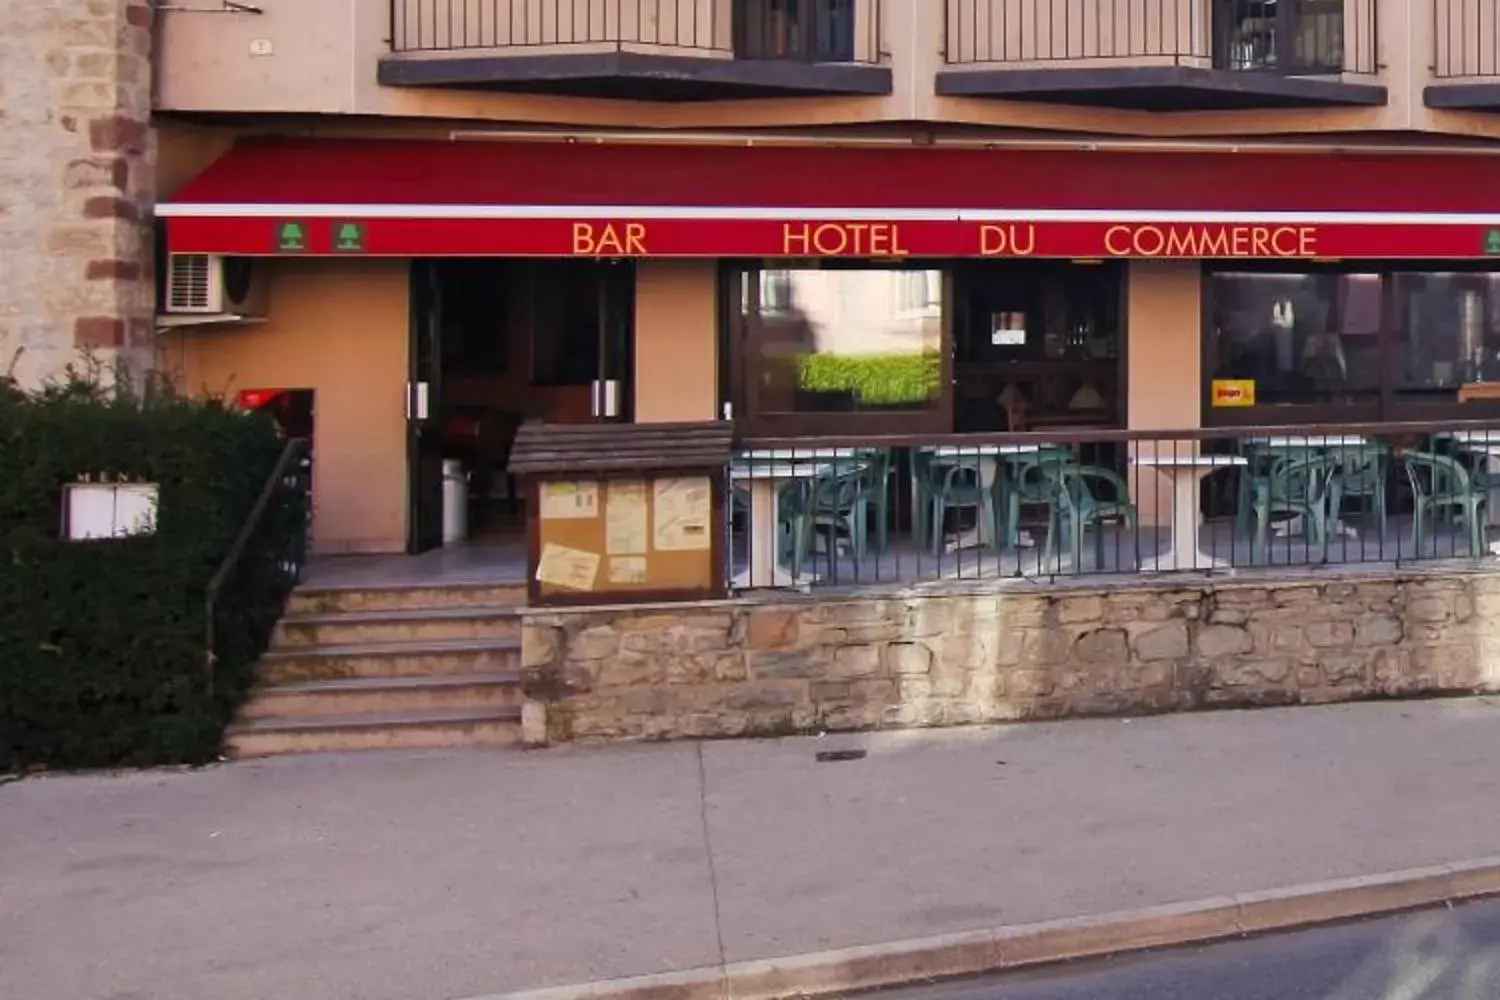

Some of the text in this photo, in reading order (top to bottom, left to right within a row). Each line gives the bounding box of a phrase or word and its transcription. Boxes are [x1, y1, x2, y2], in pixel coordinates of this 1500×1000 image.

[572, 222, 1317, 256] BAR HOTEL DU COMMERCE
